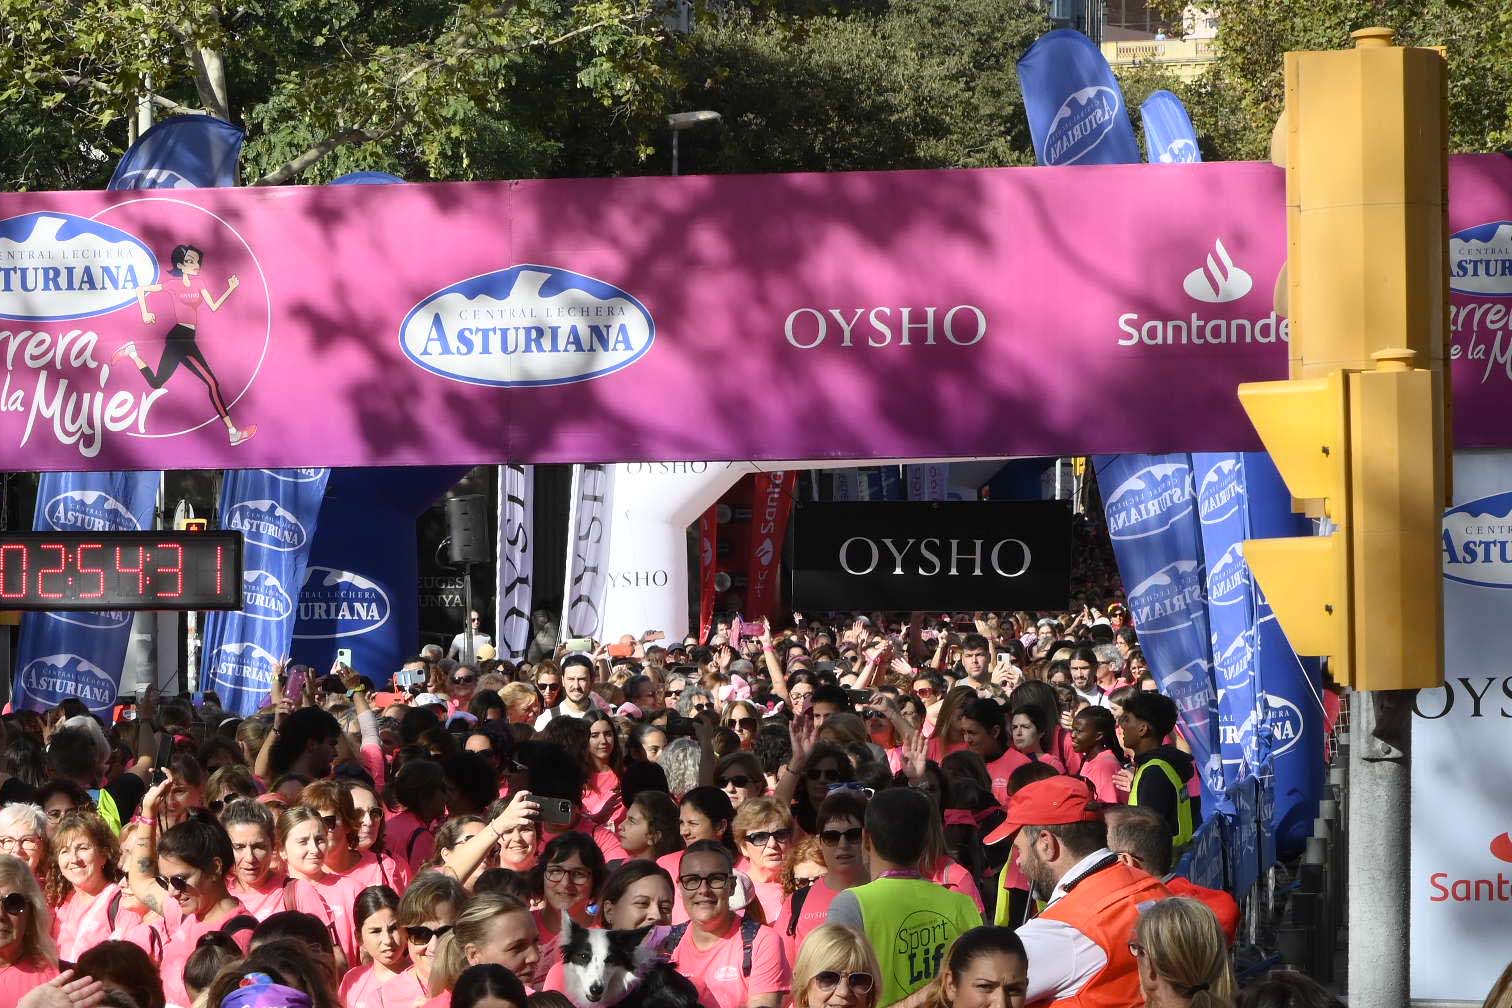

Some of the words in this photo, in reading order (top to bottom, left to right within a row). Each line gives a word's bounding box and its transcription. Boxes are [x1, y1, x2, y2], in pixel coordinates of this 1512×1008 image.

[62, 249, 134, 259] LECHERA
[1450, 258, 1512, 277] STUR
[458, 306, 538, 321] CENTRAL
[545, 304, 626, 319] LECHERA
[783, 304, 987, 351] OYSHO
[420, 311, 633, 357] ASTURIANA
[1117, 312, 1288, 346] Santand
[1468, 333, 1485, 360] la
[0, 372, 25, 411] la
[20, 364, 169, 458] Mujer
[53, 503, 129, 530] ASTURI
[761, 471, 785, 534] Santa
[503, 464, 531, 659] OYSH
[569, 464, 605, 639] OYSH
[839, 536, 1032, 577] OYSHO
[0, 544, 222, 598] 02:54:31
[608, 569, 668, 587] YSHO
[327, 591, 376, 599] LECHERA
[299, 602, 381, 621] URIANA
[26, 672, 110, 703] ASTURIANA
[217, 661, 274, 683] STURIAN
[804, 912, 829, 921] OYSH
[899, 920, 948, 955] Sport
[909, 943, 945, 985] Lif
